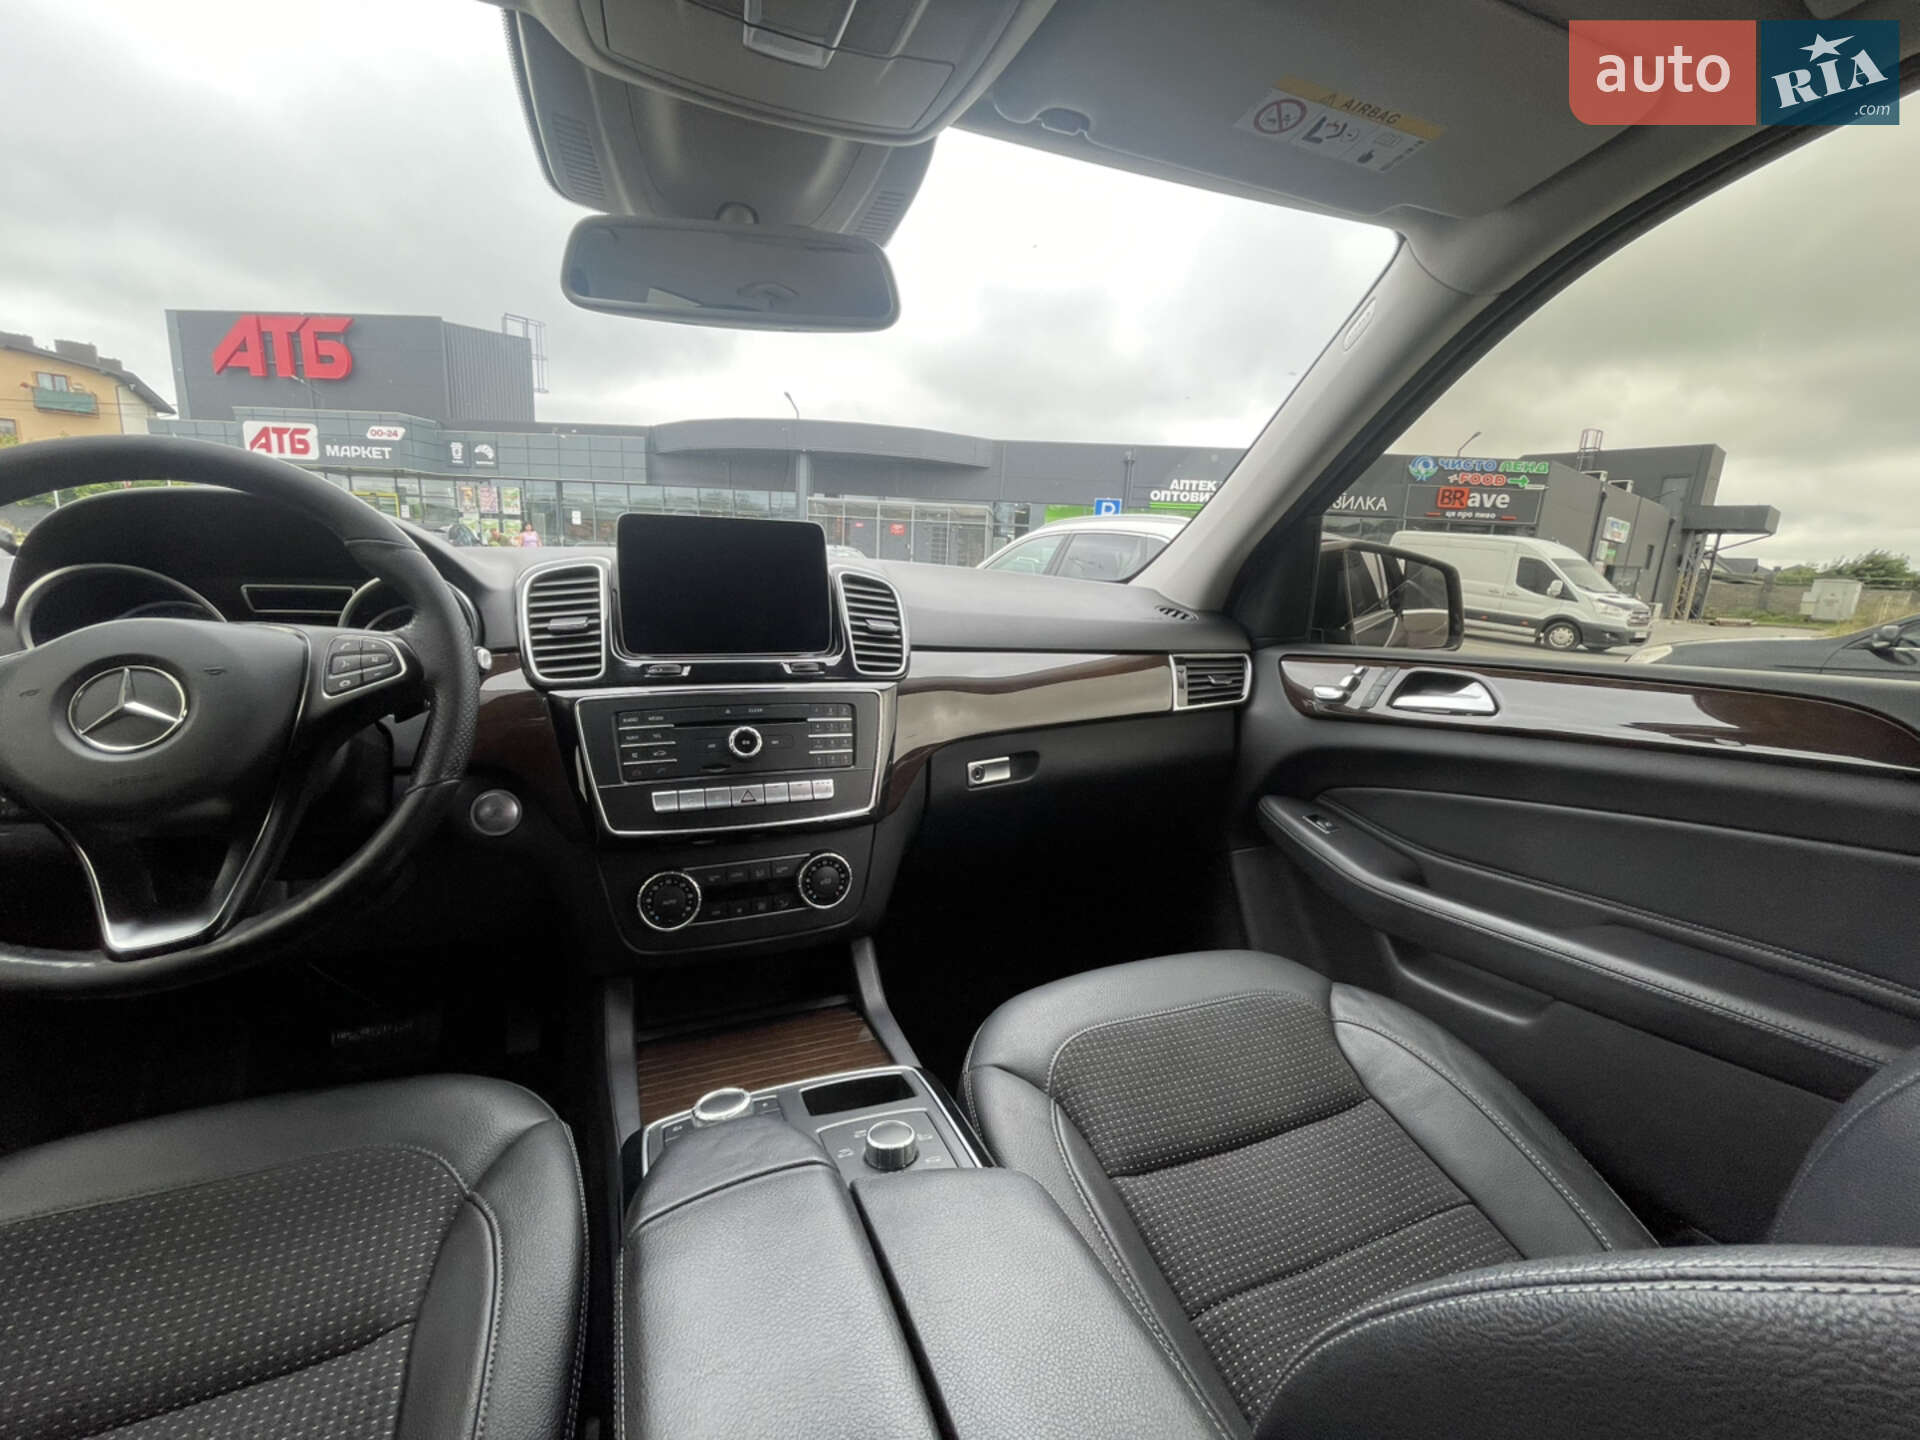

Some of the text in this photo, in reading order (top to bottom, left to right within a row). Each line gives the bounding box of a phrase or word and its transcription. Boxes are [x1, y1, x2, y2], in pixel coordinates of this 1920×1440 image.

[1343, 97, 1401, 125] AIRBAG
[212, 314, 354, 380] АТБ
[249, 426, 392, 460] АТБ МАРКЕТ
[1438, 458, 1497, 472] ЧИСТО
[1169, 479, 1218, 491] АПТЕК
[1101, 502, 1116, 515] P
[1440, 489, 1511, 509] BRave
